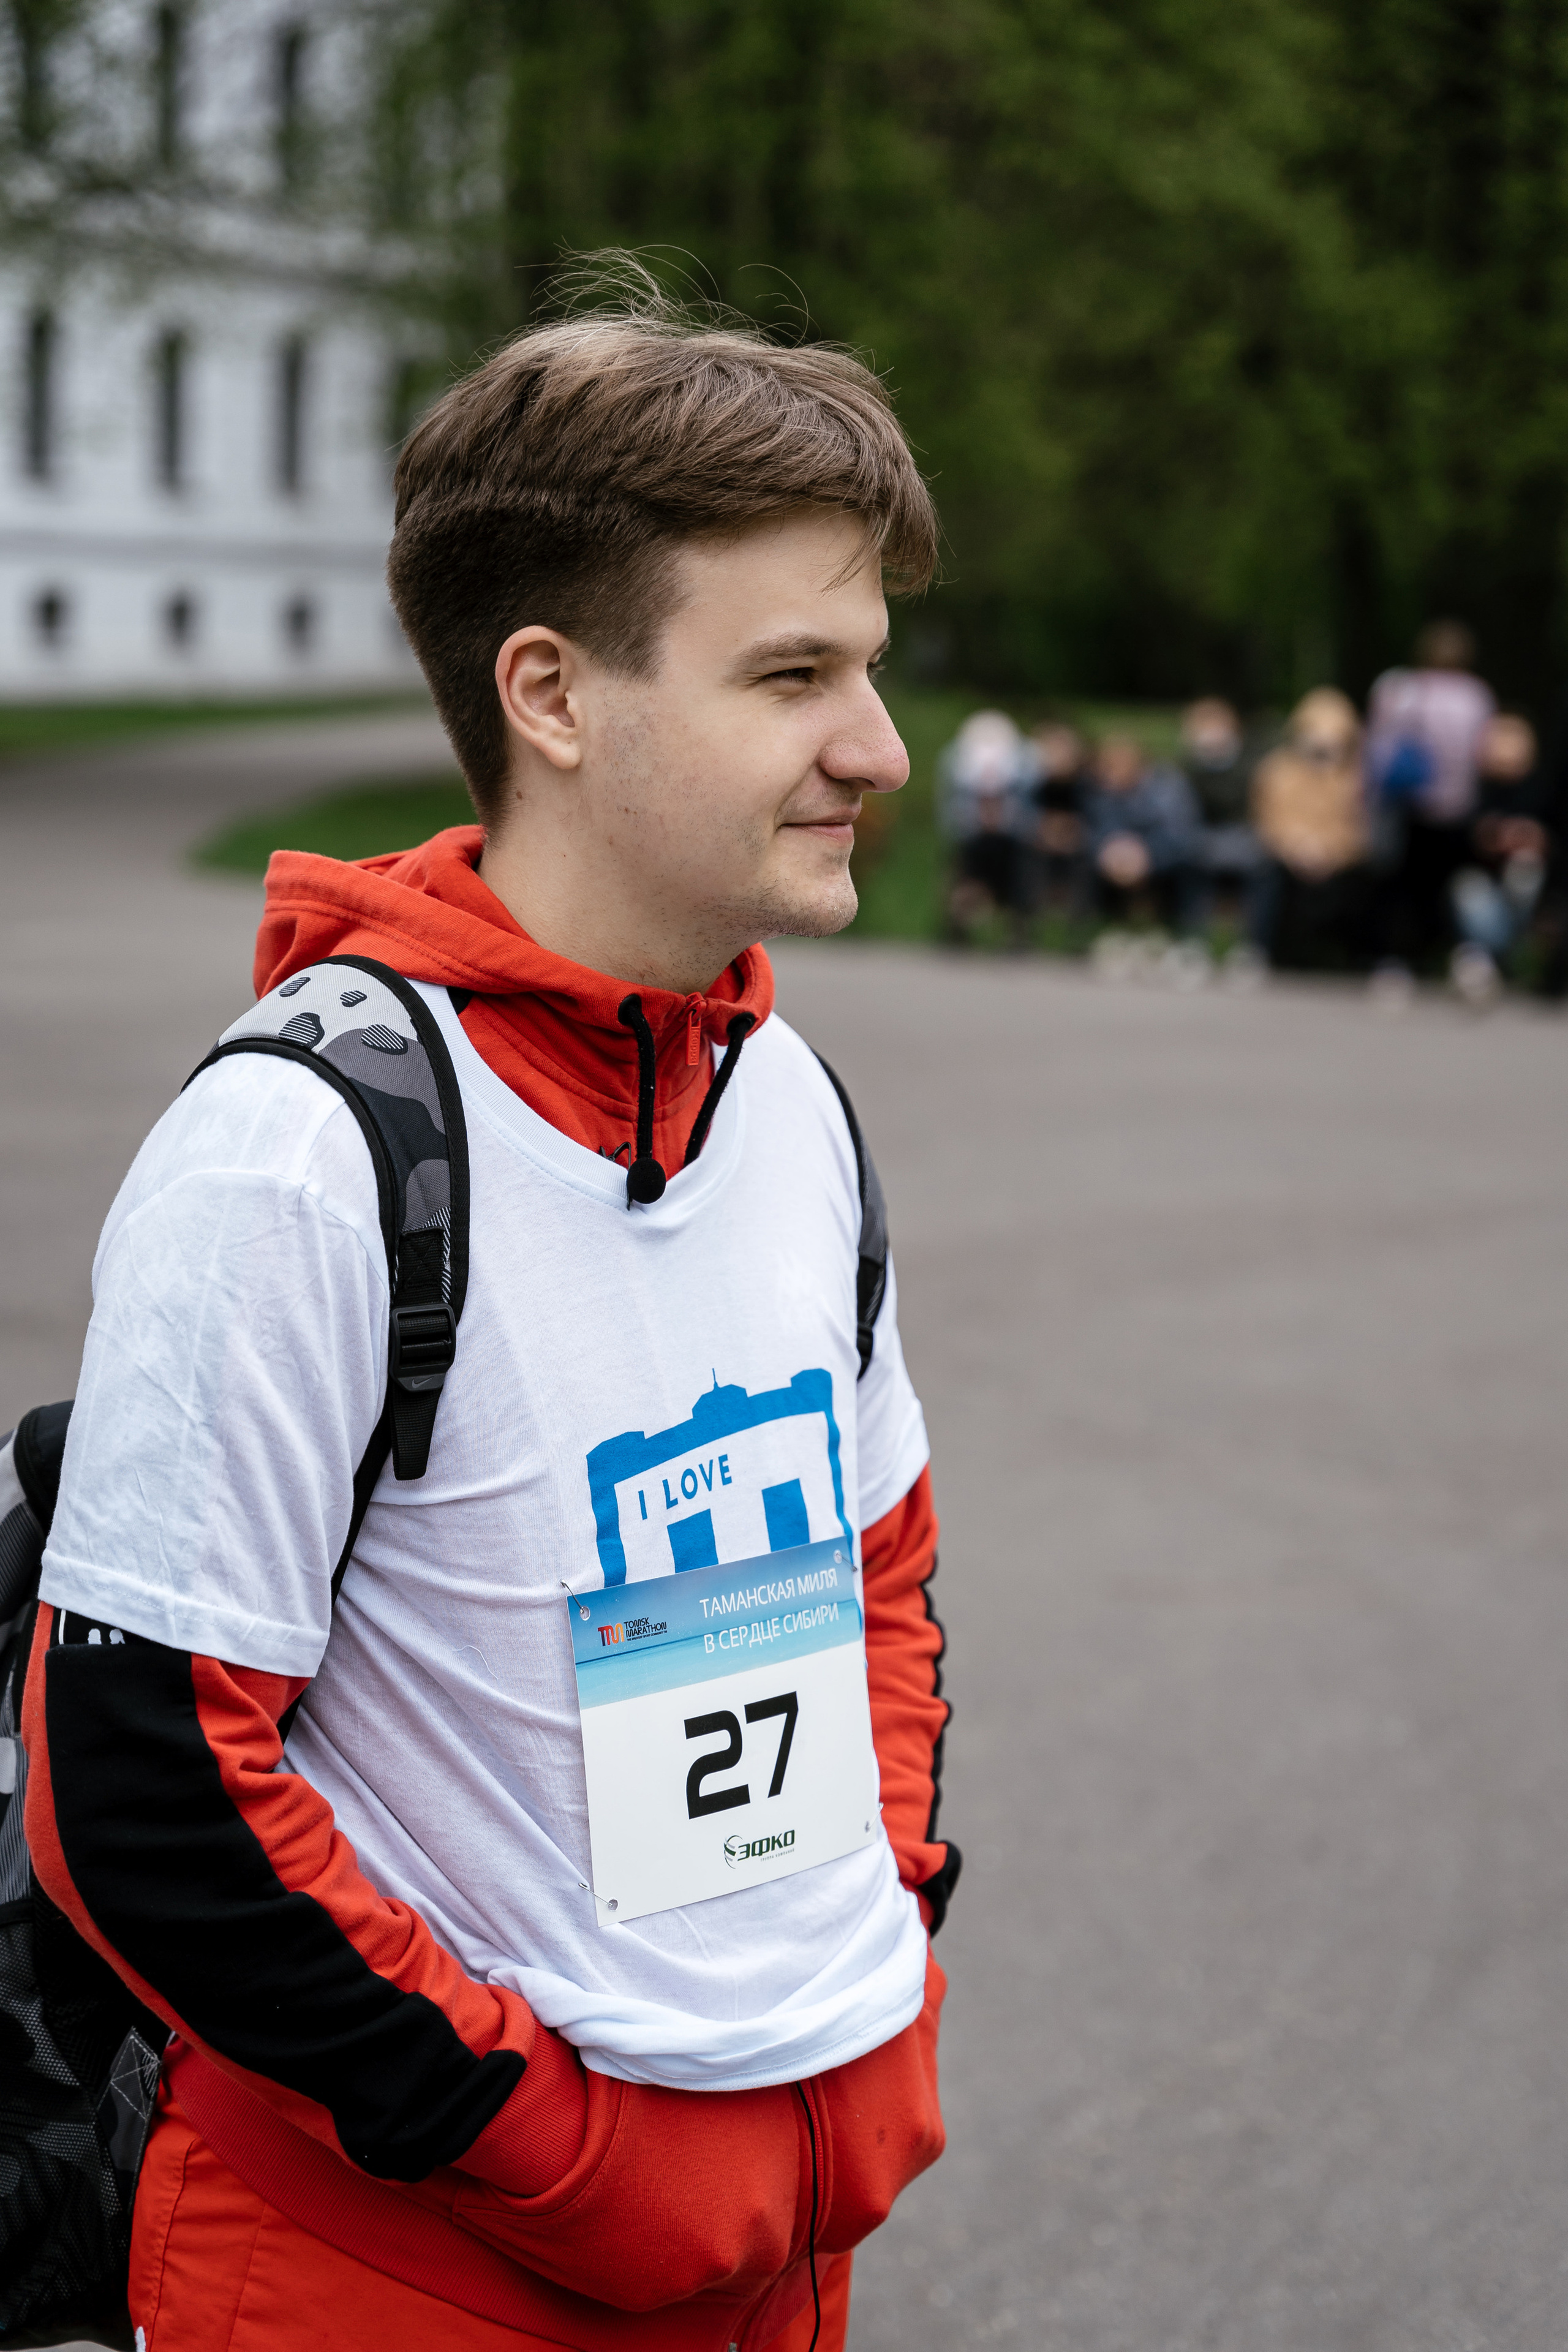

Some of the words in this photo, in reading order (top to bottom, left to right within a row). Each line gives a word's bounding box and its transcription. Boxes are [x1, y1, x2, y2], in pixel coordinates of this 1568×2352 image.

[638, 1490, 647, 1520] I
[662, 1453, 732, 1510] LOVE
[699, 1578, 795, 1618] ТАМАНСКАЯ
[797, 1568, 838, 1596] МИЛЯ
[624, 1617, 650, 1629] TOMSK
[625, 1621, 667, 1638] MARATHON
[704, 1634, 715, 1654] В
[718, 1617, 781, 1649] СЕРДЦЕ
[783, 1602, 839, 1634] СИБИРИ
[684, 1691, 799, 1820] 27
[737, 1830, 795, 1861] ЭФКО
